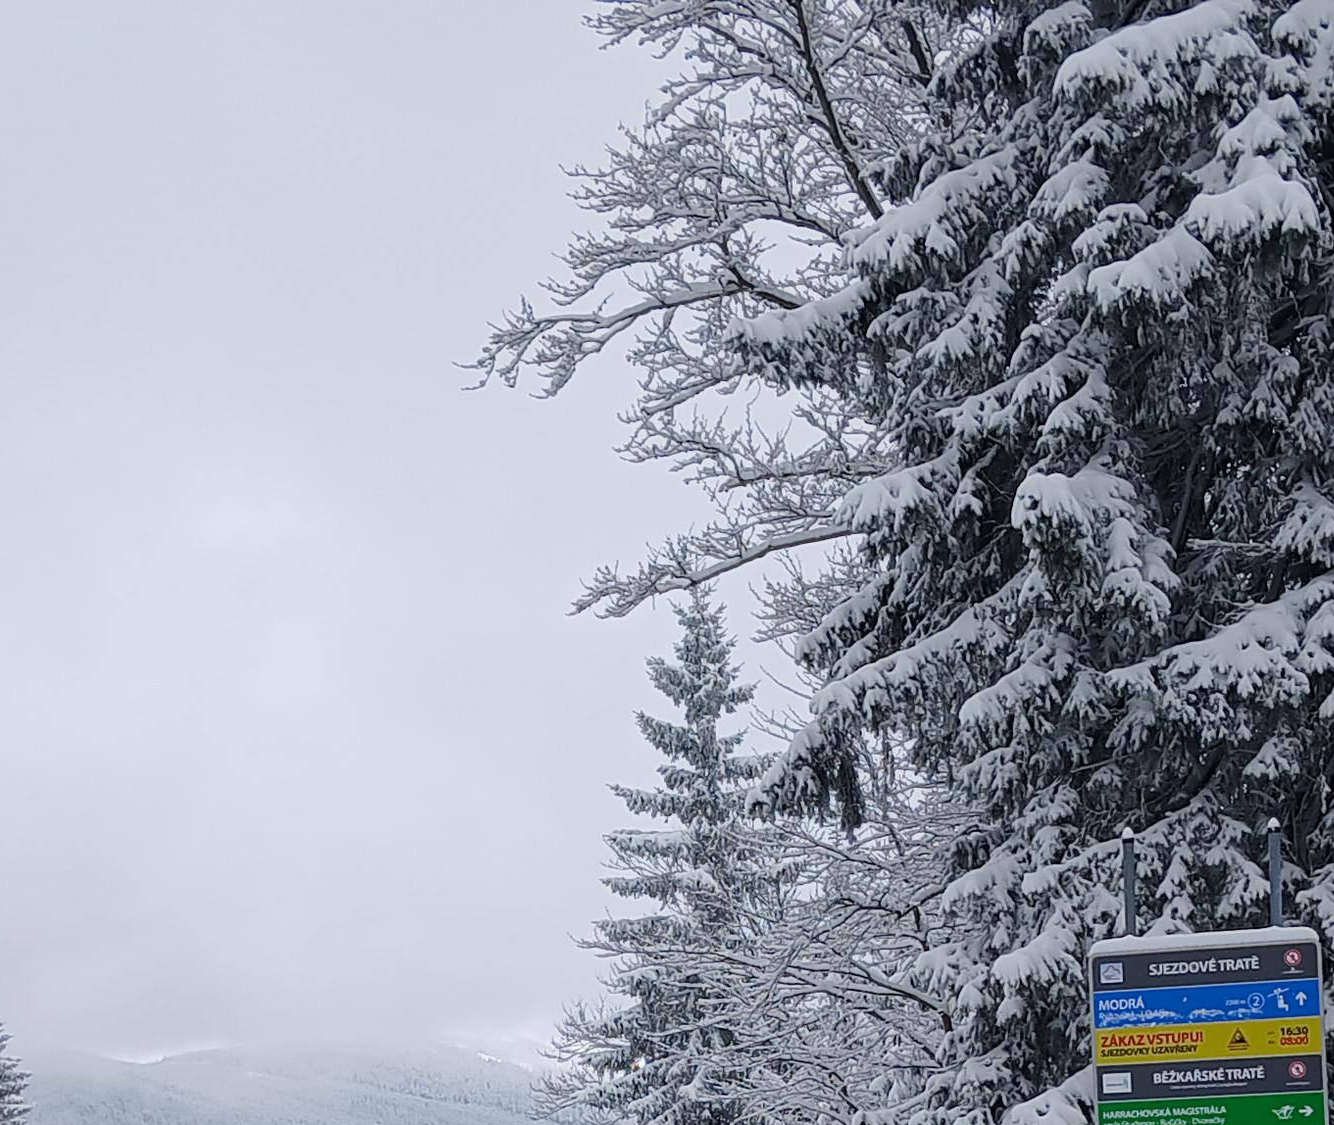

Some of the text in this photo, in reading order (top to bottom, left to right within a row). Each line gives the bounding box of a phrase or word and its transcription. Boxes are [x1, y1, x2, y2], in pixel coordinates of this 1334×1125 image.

[1148, 955, 1260, 976] SJEZDOVÉ TRATĚ
[1098, 996, 1145, 1011] MODRÁ
[1252, 996, 1261, 1007] 2
[1100, 1031, 1204, 1048] ZÁKAZ VSTUPU!
[1153, 1065, 1265, 1084] BĚŽKAŘSKÉ TRATĚ
